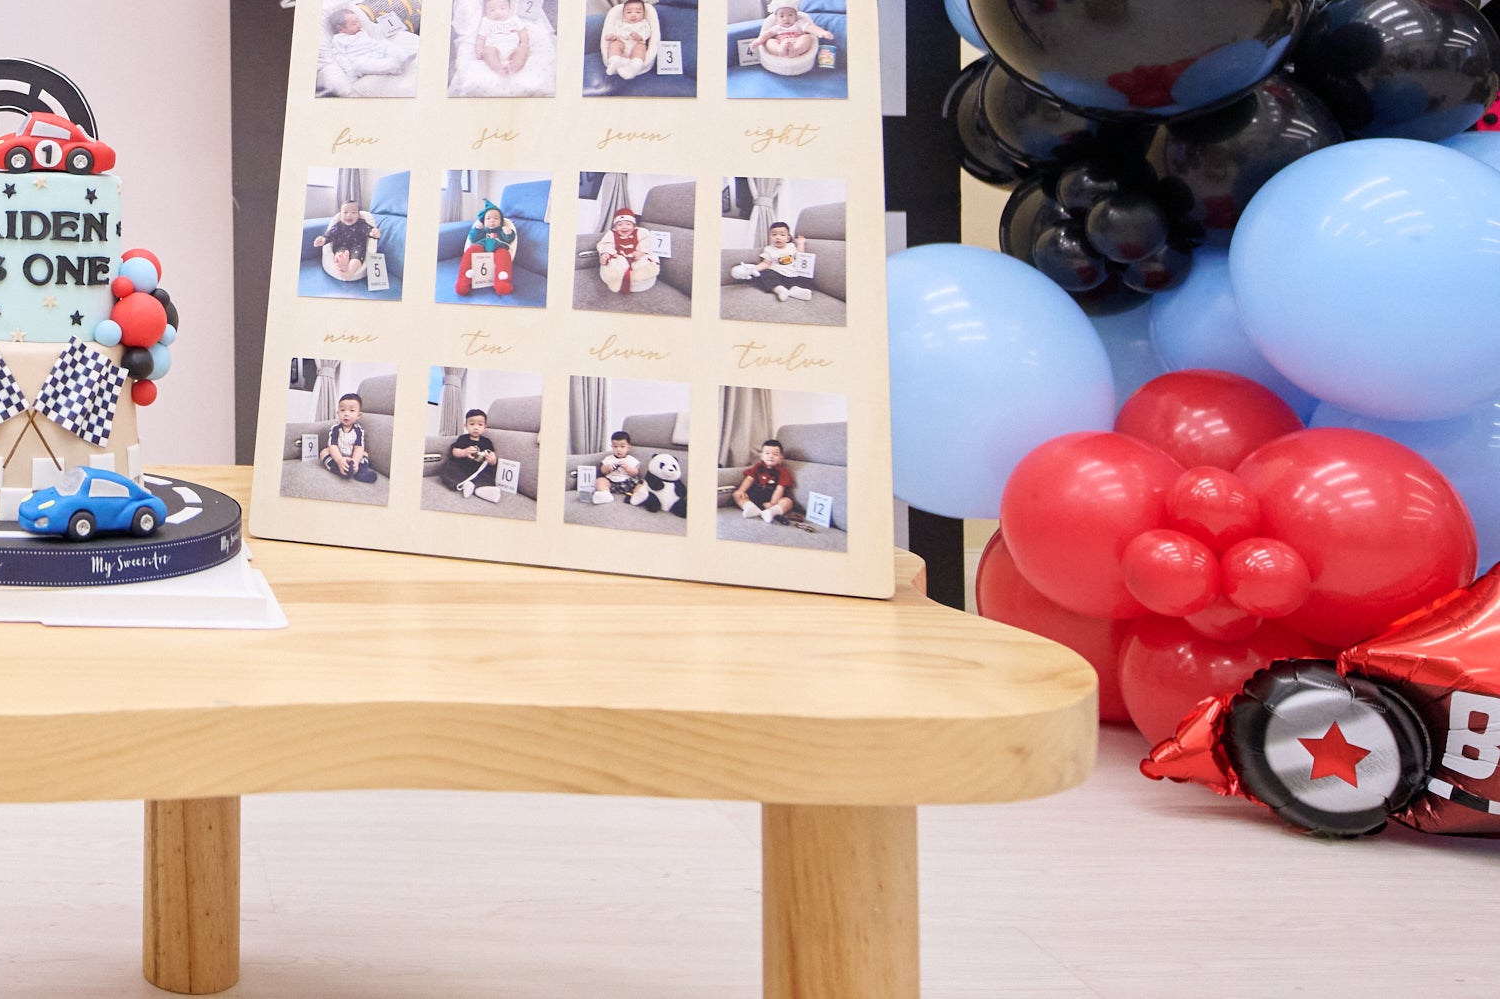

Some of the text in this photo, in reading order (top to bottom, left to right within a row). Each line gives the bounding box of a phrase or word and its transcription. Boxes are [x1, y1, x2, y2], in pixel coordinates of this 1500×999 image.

[525, 0, 533, 13] 2
[666, 50, 674, 64] 3
[331, 122, 822, 154] five six seven eight
[41, 144, 53, 165] 1
[657, 238, 663, 248] 7
[22, 253, 111, 287] ONE
[374, 263, 381, 278] 5
[480, 262, 488, 276] 6
[801, 259, 808, 269] 8
[323, 329, 379, 344] nine
[589, 334, 671, 360] eleven
[308, 441, 314, 453] 9
[501, 468, 514, 482] 10
[813, 501, 825, 516] 12
[91, 551, 172, 579] My Sweet Art
[1441, 690, 1500, 780] B
